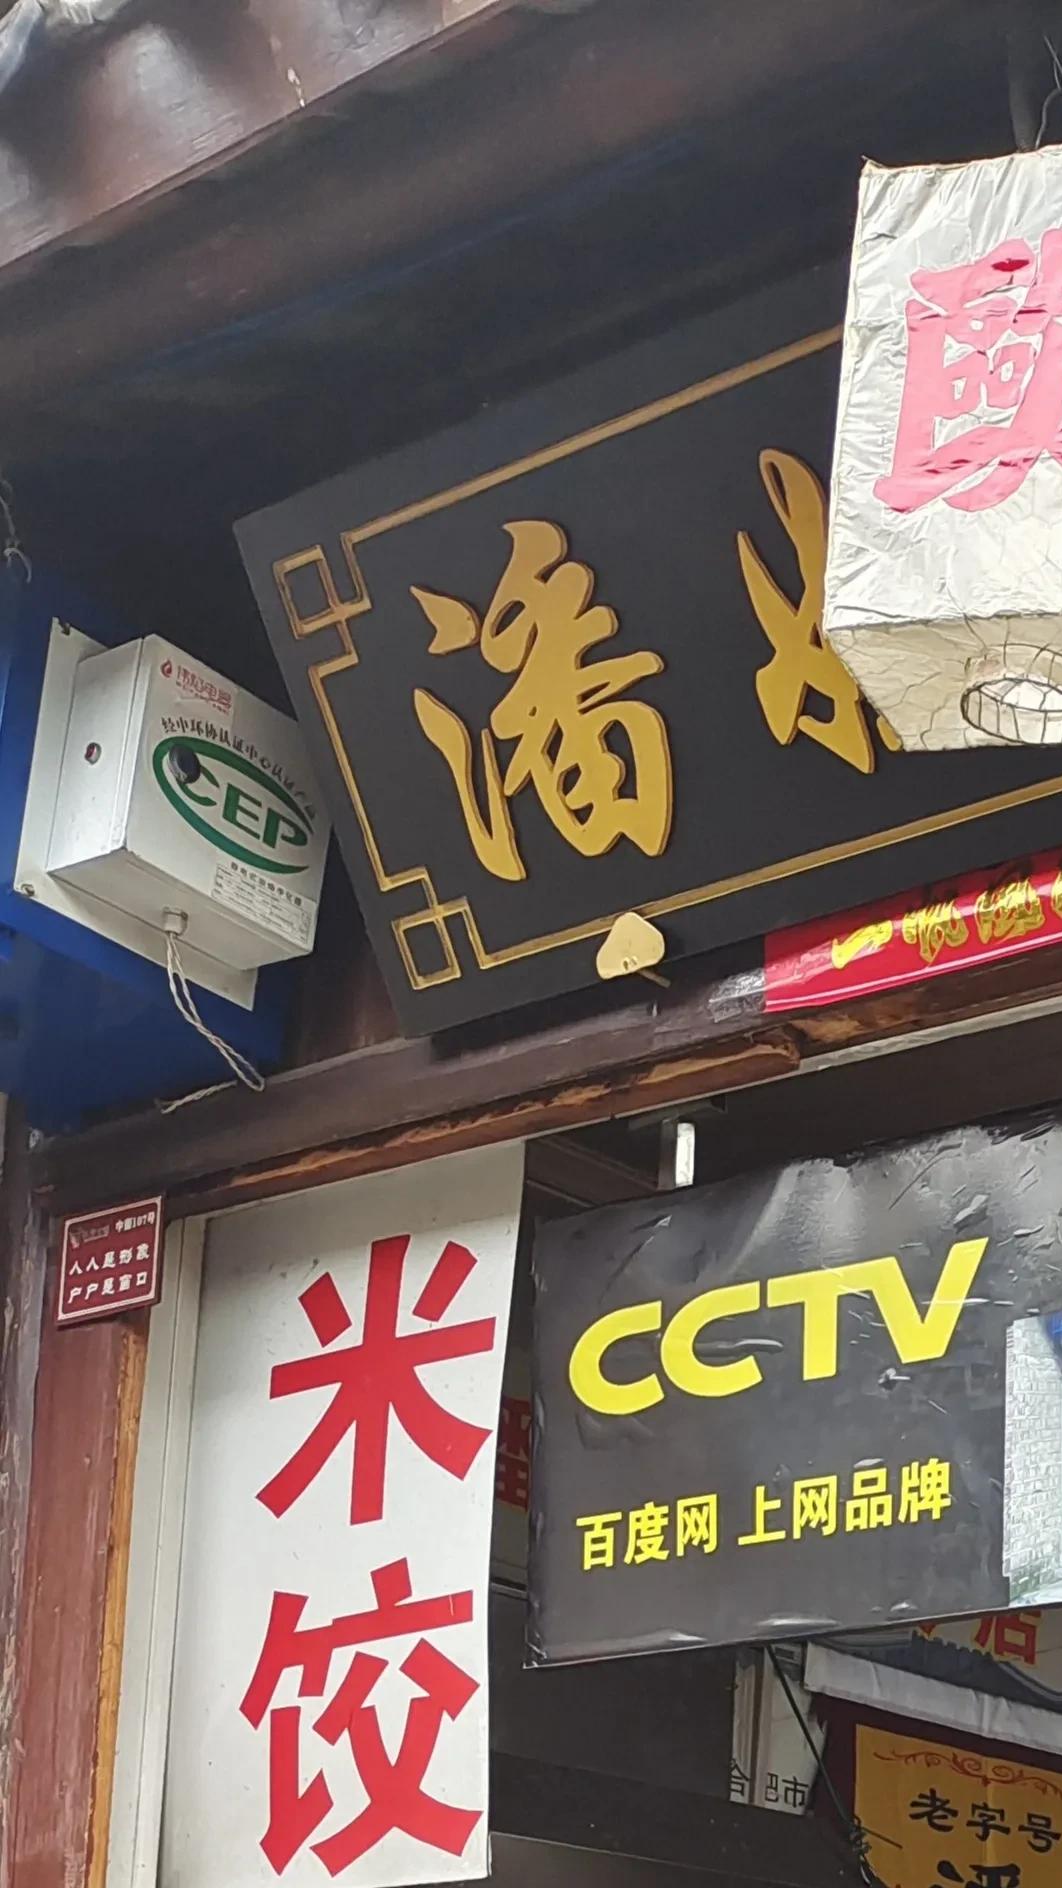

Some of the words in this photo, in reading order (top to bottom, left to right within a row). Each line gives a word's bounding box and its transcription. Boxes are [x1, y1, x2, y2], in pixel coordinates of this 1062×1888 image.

[68, 1271, 149, 1304] 户户是窗口
[69, 1243, 150, 1275] 人人是形象
[568, 1237, 990, 1416] CCTV
[239, 1233, 498, 1878] 米饺
[576, 1493, 720, 1570] 百度网
[738, 1457, 952, 1547] 上网品牌
[909, 1787, 1062, 1853] 老字号
